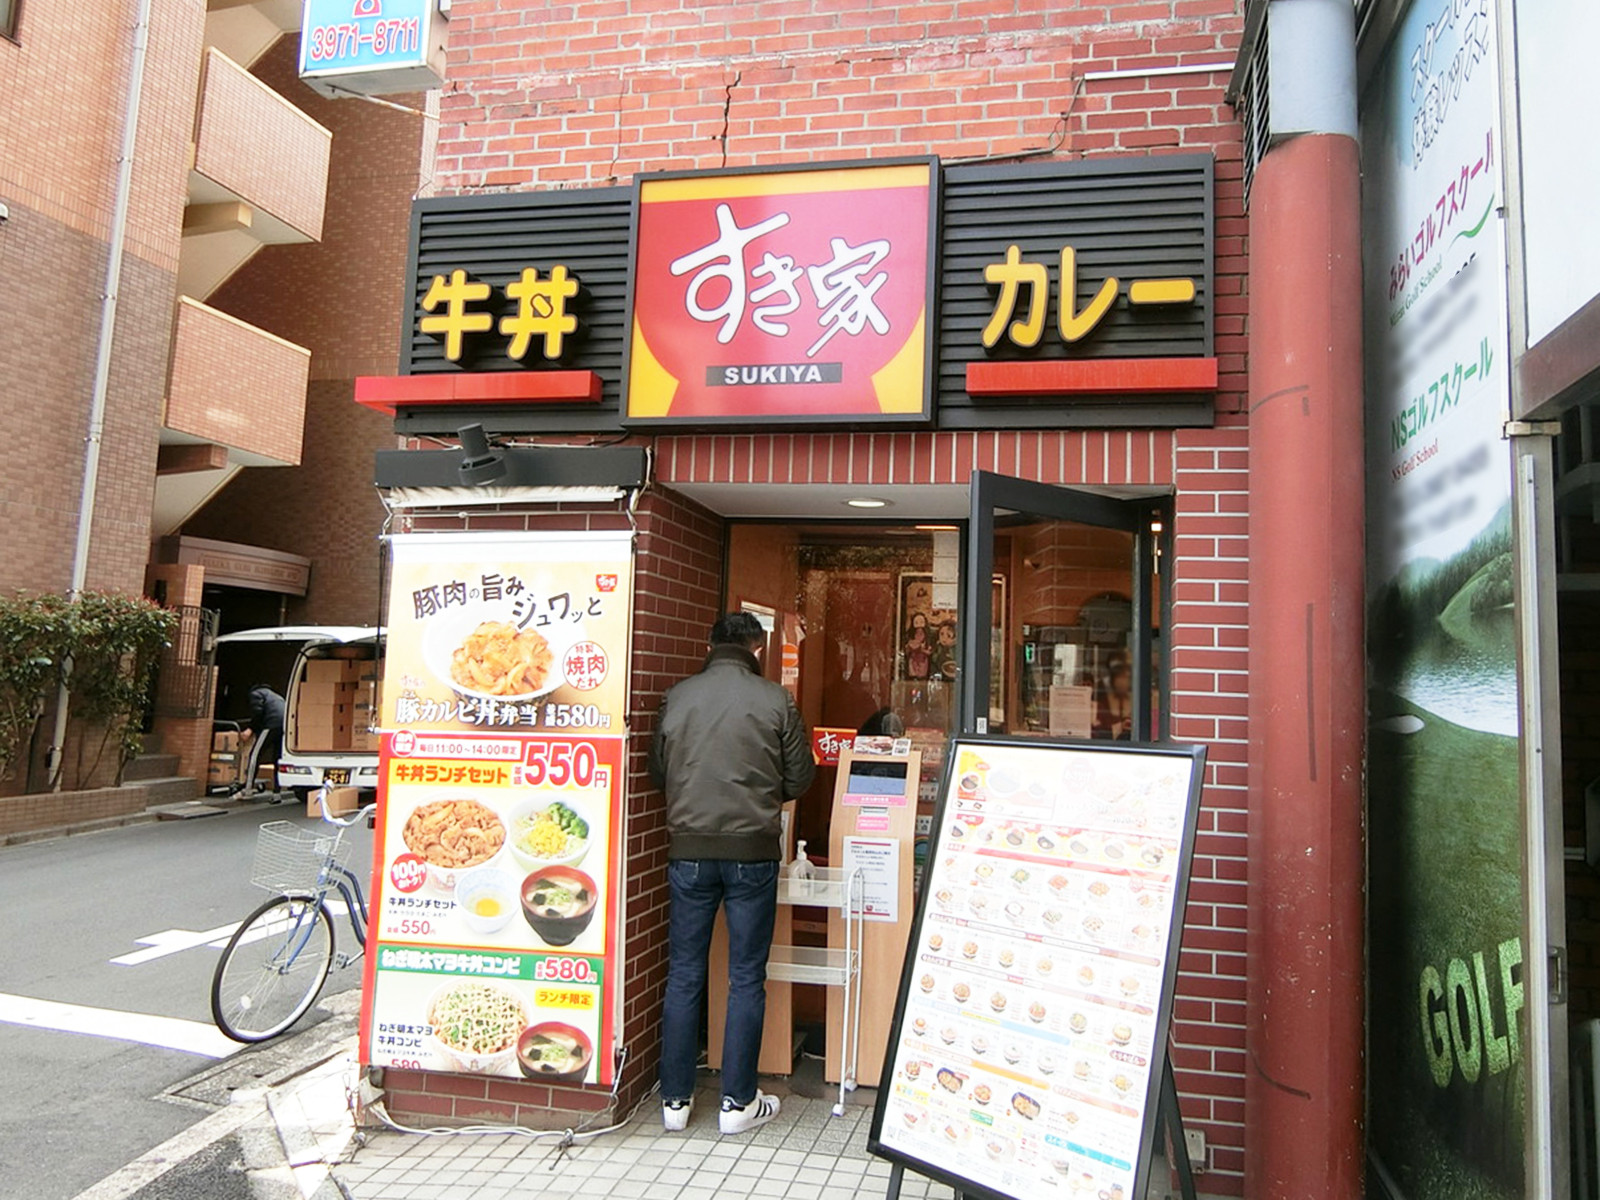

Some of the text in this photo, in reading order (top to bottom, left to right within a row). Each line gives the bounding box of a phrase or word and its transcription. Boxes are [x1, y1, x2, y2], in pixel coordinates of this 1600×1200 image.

[311, 18, 419, 60] 3971-8711
[670, 203, 892, 358] すき家
[981, 244, 1196, 348] カレー
[1405, 286, 1419, 310] Golf
[1419, 254, 1442, 295] School
[419, 264, 580, 362] 牛丼
[723, 364, 823, 385] SUKIYA
[1391, 336, 1493, 453] NSゴルフスクール
[1402, 453, 1416, 477] Golf
[1416, 438, 1438, 467] School
[412, 573, 525, 619] 豚肉の旨み
[512, 593, 602, 629] ジュワッと
[566, 654, 605, 675] 焼肉
[394, 697, 538, 727] 豚カルビ丼弁当
[395, 764, 508, 785] 牛丼ランチセット
[525, 743, 608, 788] 550円
[389, 897, 457, 910] 牛丼ランチセット
[539, 991, 592, 1007] ランチ限定
[1420, 937, 1524, 1088] GOLF
[378, 1035, 422, 1048] 牛丼コンビ
[379, 1023, 433, 1036] ねぎ明太マヨ
